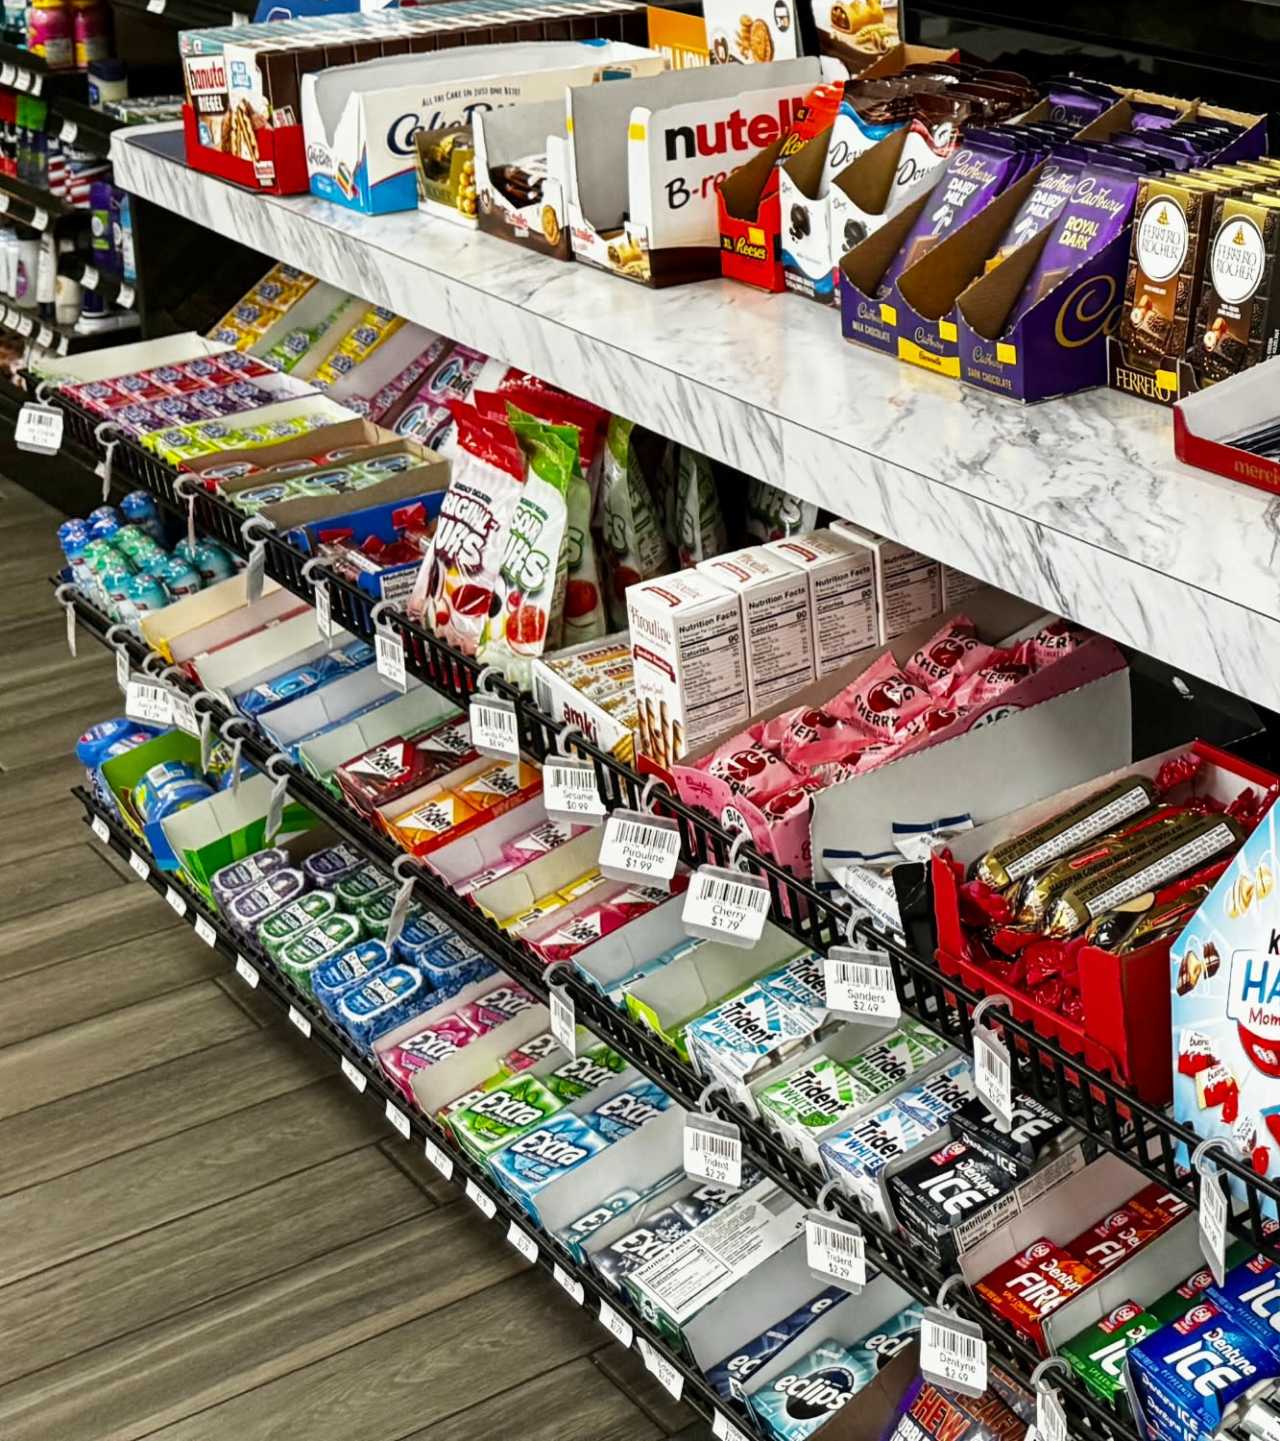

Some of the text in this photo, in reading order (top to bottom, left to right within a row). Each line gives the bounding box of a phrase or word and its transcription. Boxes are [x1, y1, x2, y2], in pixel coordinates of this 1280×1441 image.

[1071, 176, 1125, 218] Cadbury
[1066, 216, 1098, 236] ROYAL
[1142, 223, 1181, 245] FERRERO
[1058, 230, 1092, 251] DARK
[1140, 238, 1181, 259] ROCHER
[623, 845, 665, 865] Pirouline
[847, 988, 886, 1004] Sanders
[720, 1000, 776, 1045] Trident
[511, 1130, 588, 1165] Extra
[954, 1159, 1001, 1196] Dentyne
[919, 1171, 982, 1218] ICE
